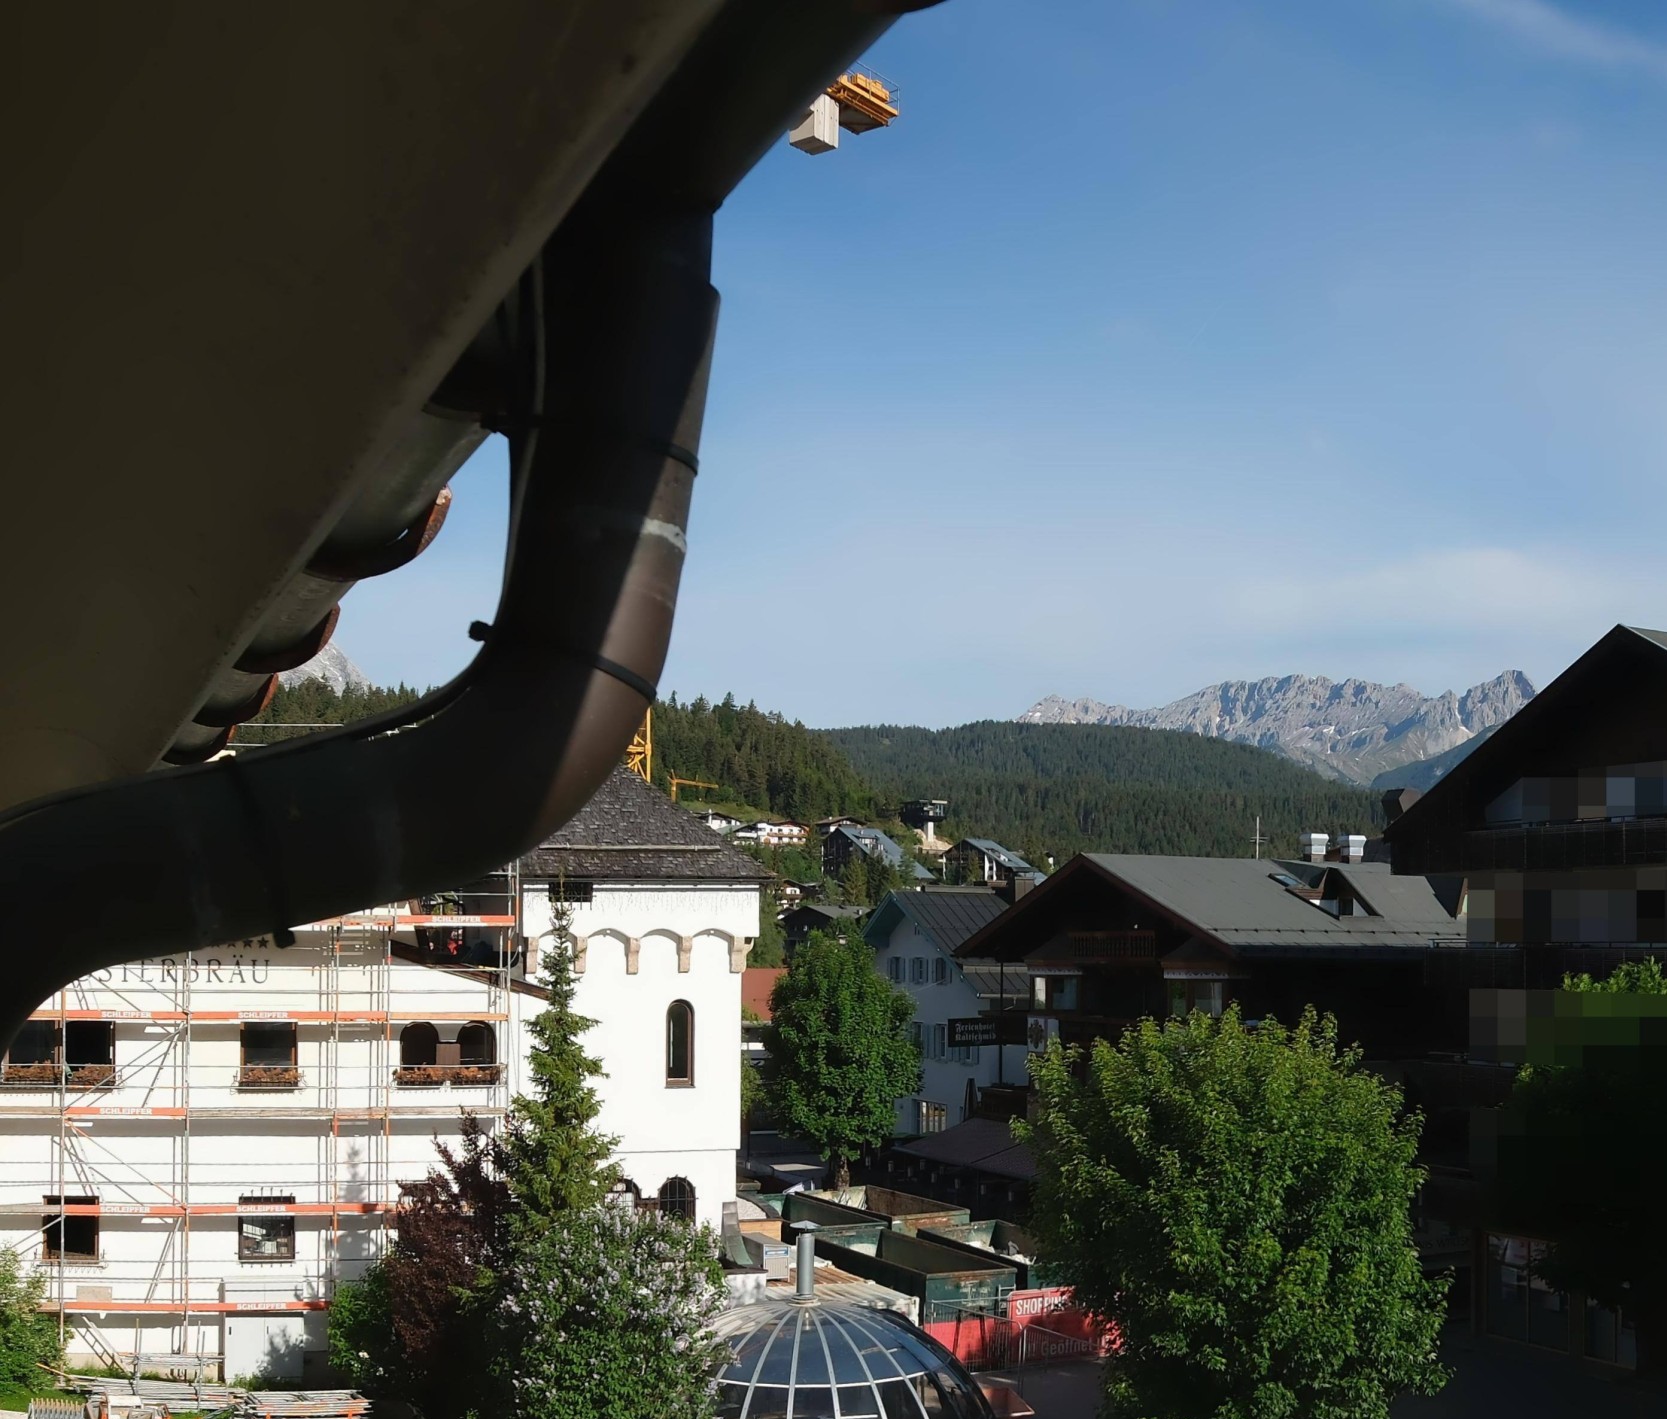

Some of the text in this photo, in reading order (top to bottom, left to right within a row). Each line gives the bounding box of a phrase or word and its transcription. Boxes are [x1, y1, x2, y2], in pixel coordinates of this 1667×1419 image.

[101, 1011, 152, 1019] SCHLEIPFER
[238, 1011, 288, 1019] SCHLEIPFER
[100, 1107, 152, 1115] SCHLEIPFER
[236, 1205, 286, 1213] SCHLEIPFER
[236, 1302, 286, 1310] SCHLEIPFER
